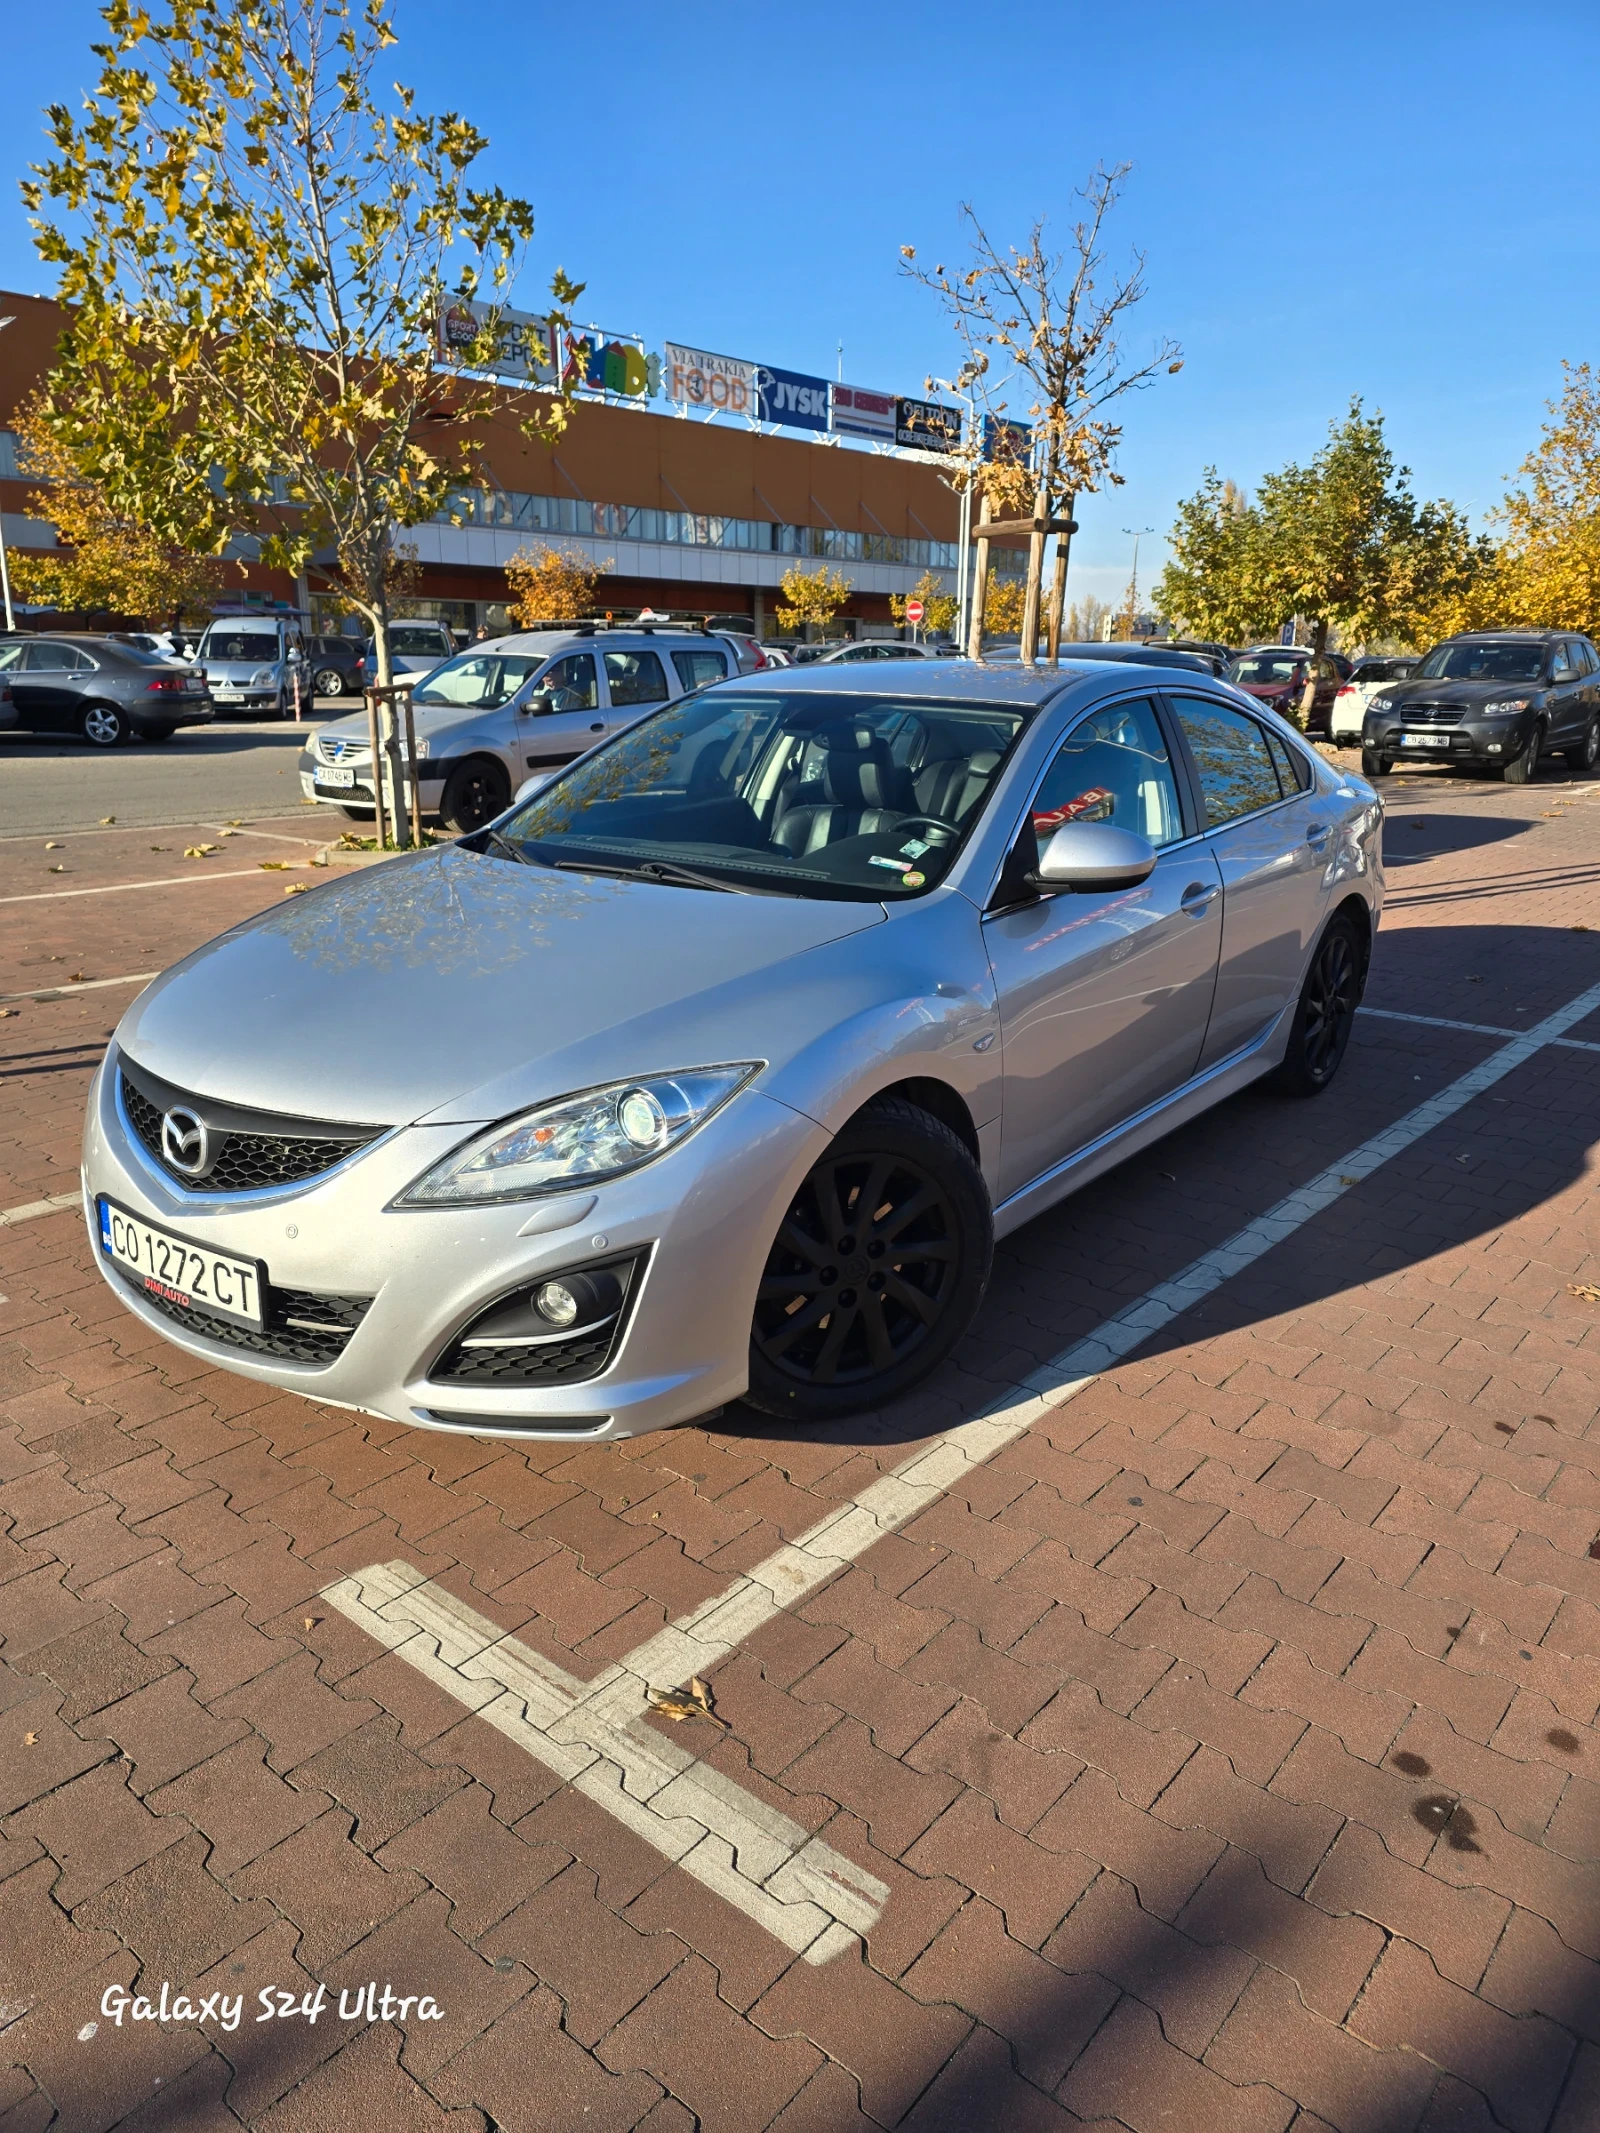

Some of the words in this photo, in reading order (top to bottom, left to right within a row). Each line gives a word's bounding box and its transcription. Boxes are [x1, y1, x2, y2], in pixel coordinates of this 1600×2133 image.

[447, 319, 477, 333] SPORT
[451, 331, 475, 341] 2000
[672, 349, 696, 367] VIA
[699, 355, 747, 378] TRAKIA
[672, 364, 748, 410] FOOD
[773, 382, 827, 418] JYSK
[1284, 624, 1292, 644] P
[113, 1215, 138, 1263] CO
[145, 1233, 208, 1297] 1272
[213, 1261, 253, 1312] CT
[145, 1276, 163, 1295] DIMI
[165, 1287, 190, 1307] AUTO
